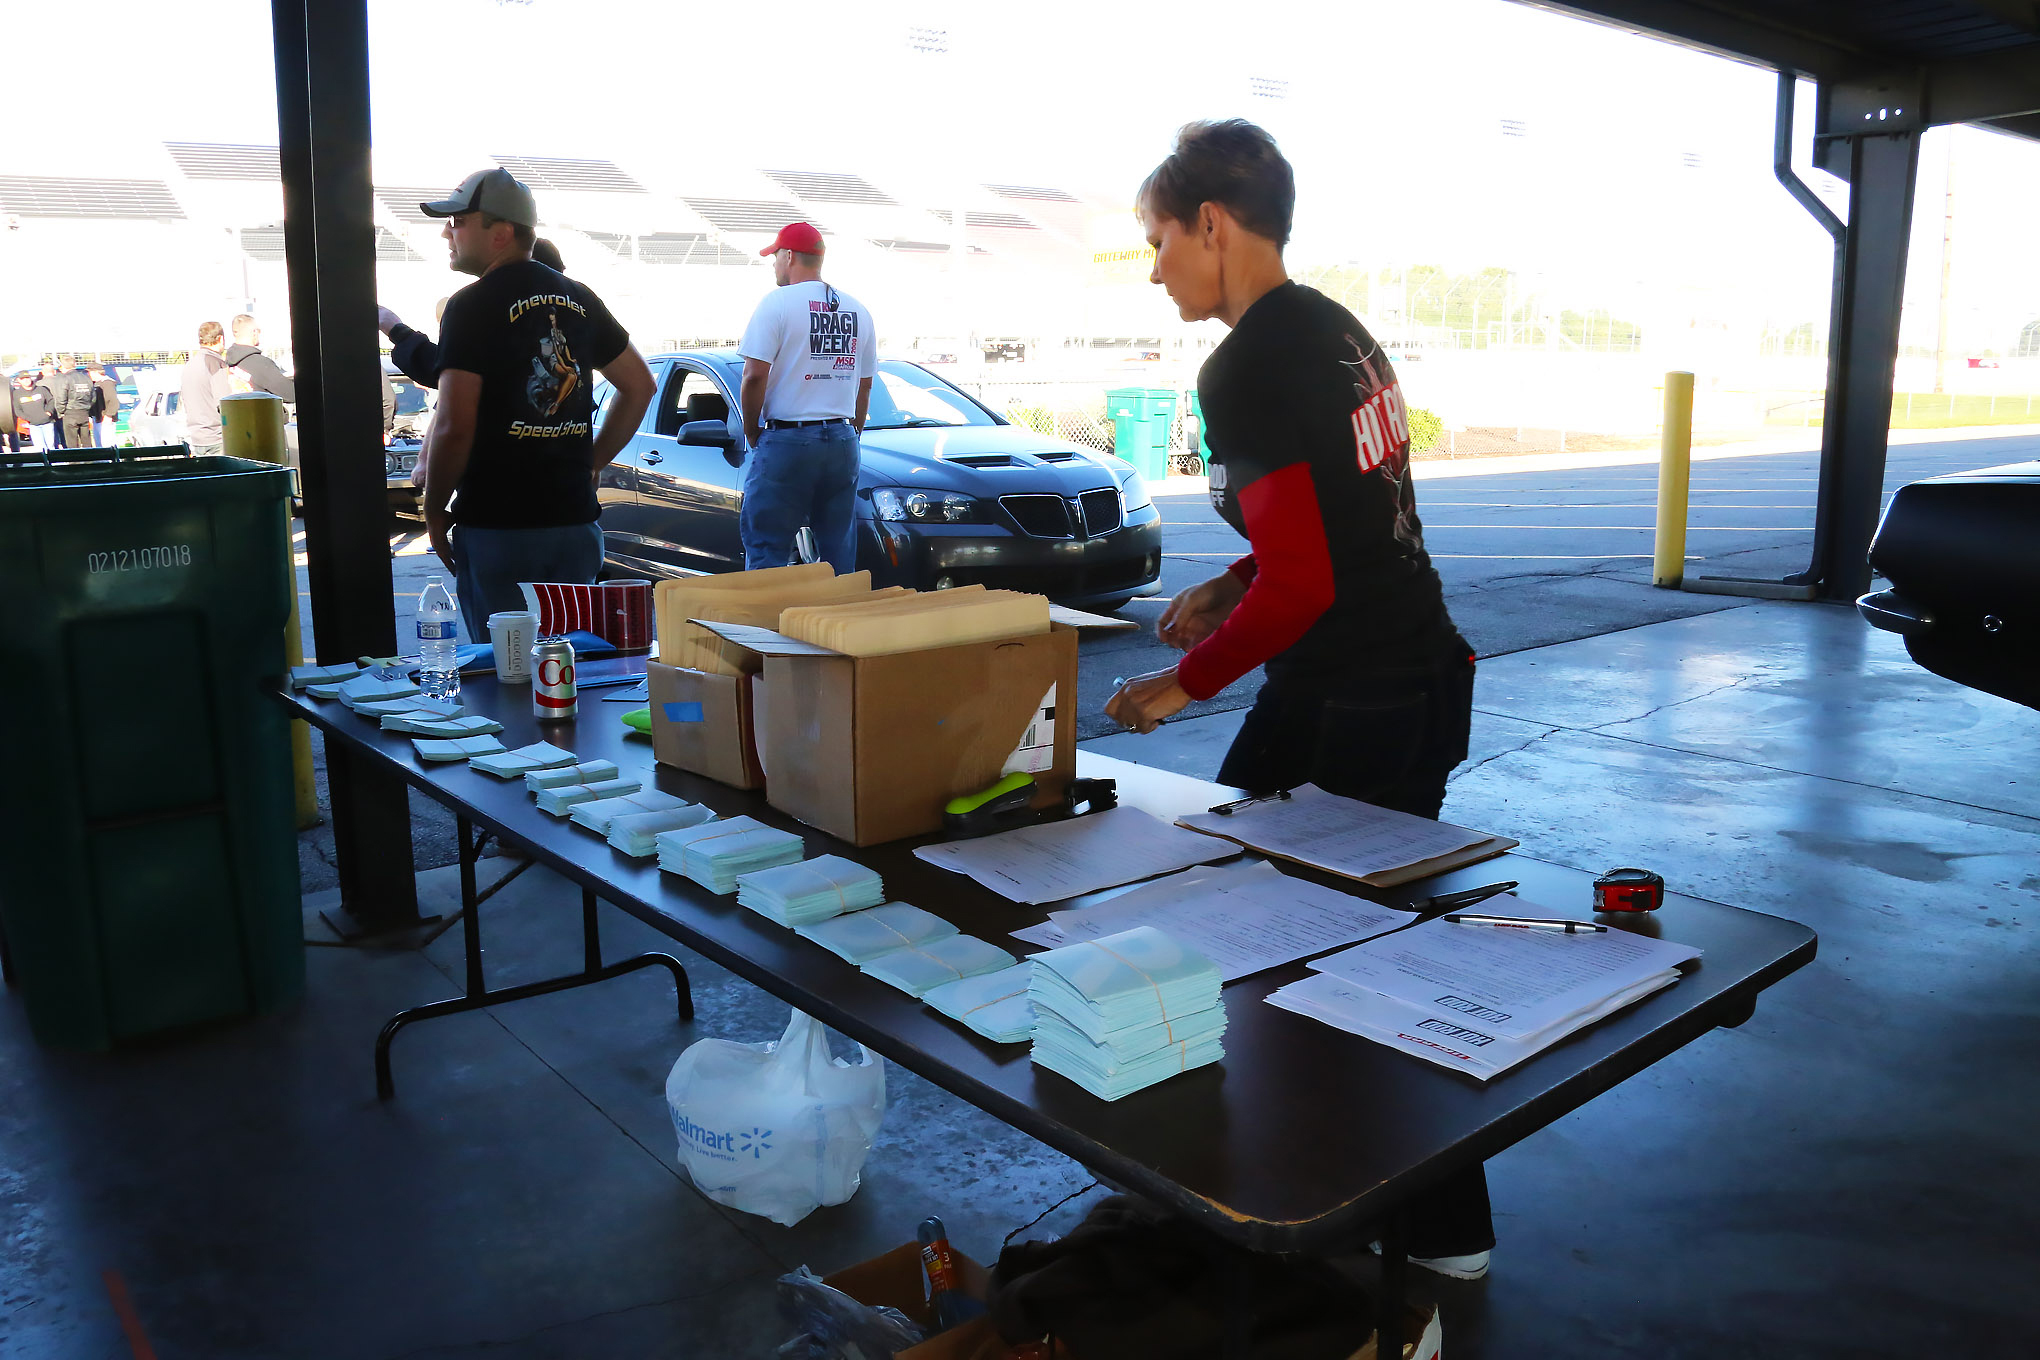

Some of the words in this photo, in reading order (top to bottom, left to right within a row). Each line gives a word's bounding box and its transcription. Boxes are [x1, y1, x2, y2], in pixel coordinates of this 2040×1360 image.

[1093, 249, 1141, 263] GATEWAY
[509, 294, 587, 323] Chevrolet
[809, 311, 852, 335] DRAG
[809, 334, 851, 354] WEEK
[835, 356, 856, 366] MSD
[1352, 395, 1394, 471] HOT
[88, 544, 191, 574] 0212107018
[1440, 997, 1474, 1014] ROD
[1470, 1005, 1510, 1023] HOT
[1421, 1020, 1457, 1037] ROD
[1452, 1028, 1491, 1046] HOT
[943, 1252, 950, 1262] 3
